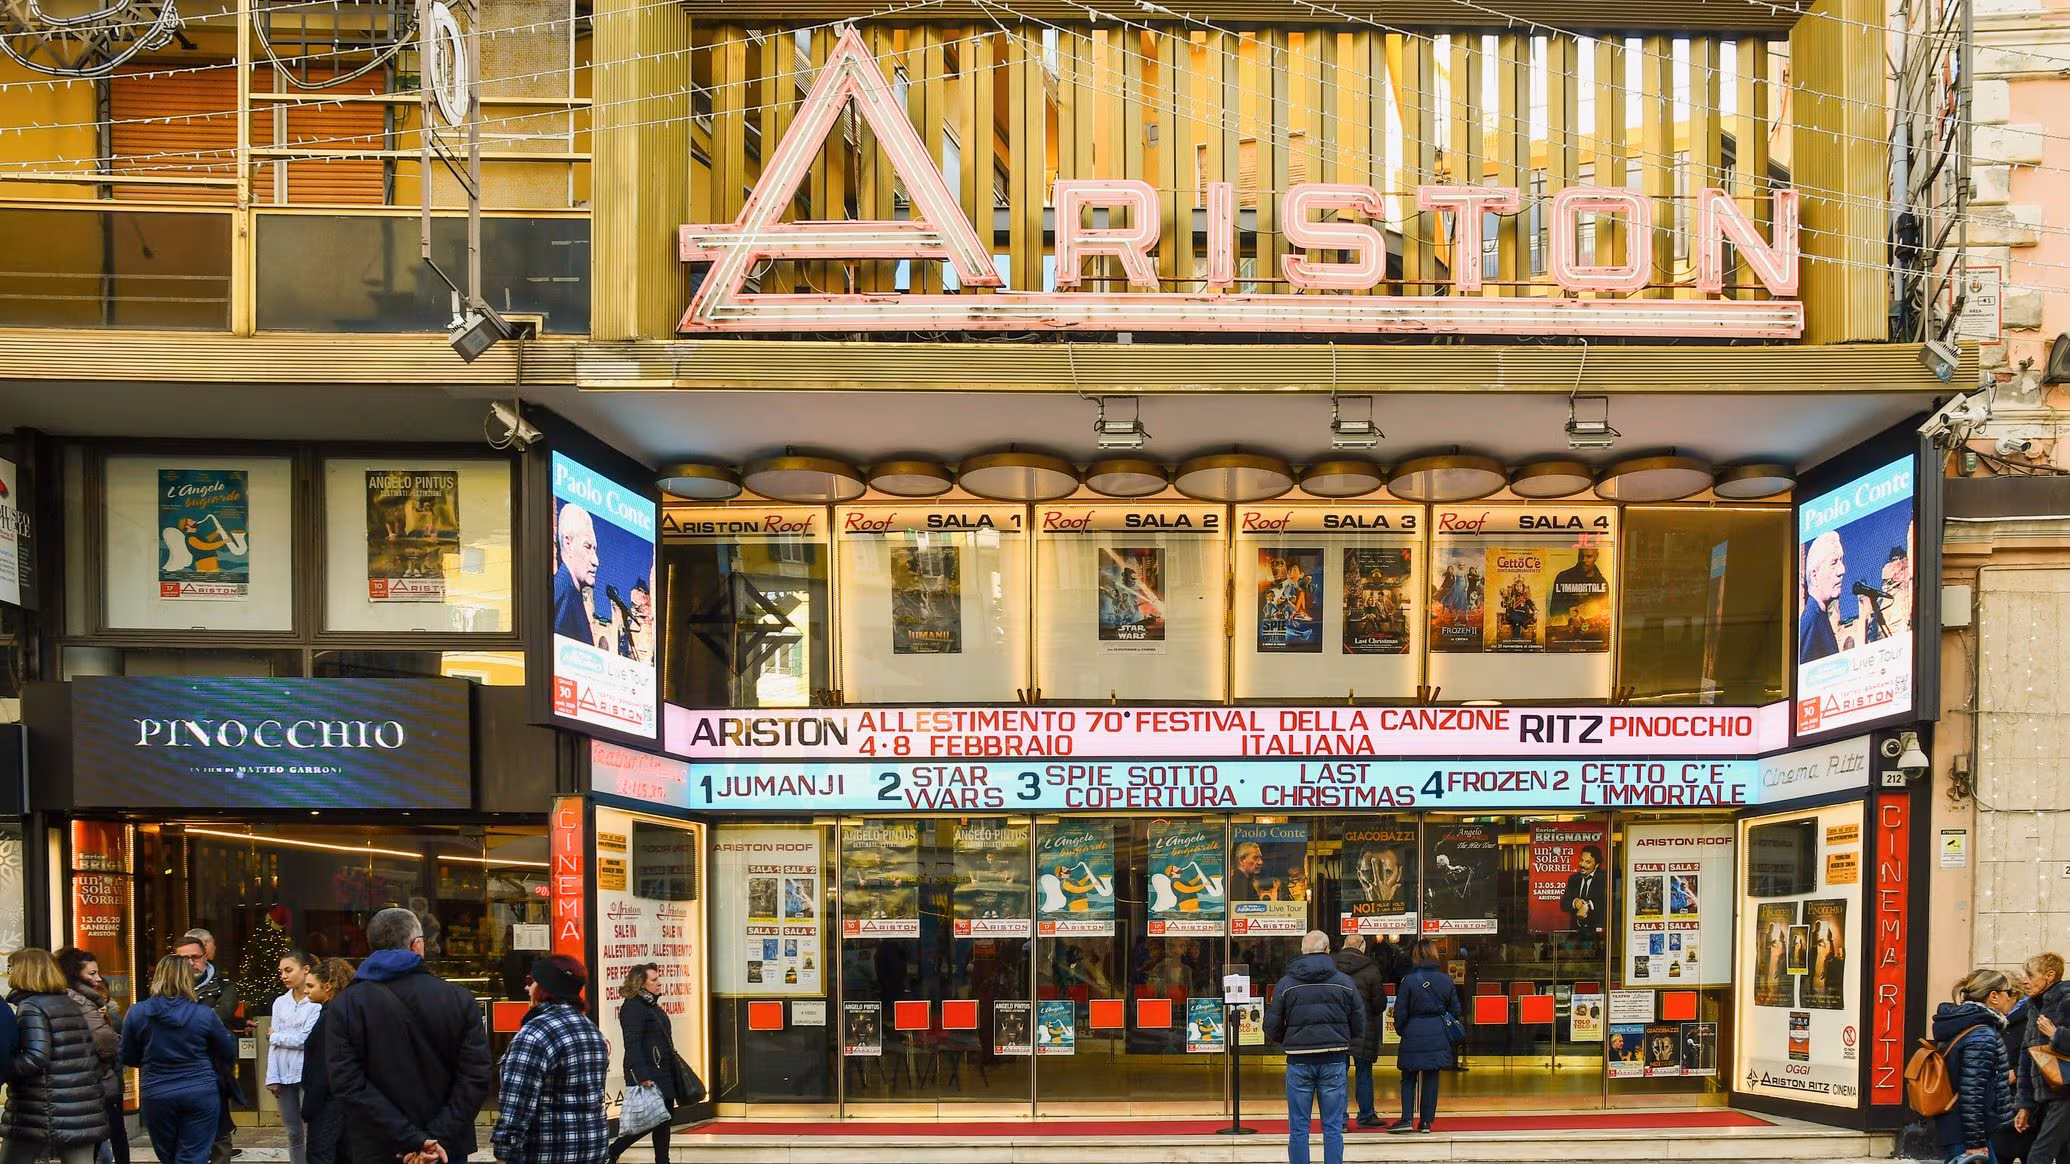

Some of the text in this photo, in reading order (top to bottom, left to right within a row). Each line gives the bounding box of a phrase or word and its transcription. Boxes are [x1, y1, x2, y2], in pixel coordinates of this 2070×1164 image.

[678, 24, 1804, 336] ARISTON
[167, 480, 225, 498] L'Angelo
[369, 476, 454, 489] ANGELO PINTUS
[555, 463, 651, 531] Paolo Conte
[1805, 470, 1910, 532] Paolo Conte
[661, 512, 815, 537] ARISTON Roof
[845, 512, 1021, 536] Roof SALA 1
[1043, 510, 1219, 535] Roof SALA 2
[1242, 511, 1417, 535] Roof SALA 3
[1438, 512, 1610, 536] Roof SALA 4
[1555, 583, 1606, 593] L'IMMORTALE
[1263, 620, 1287, 631] SPIE
[1441, 626, 1472, 635] FROZEN
[1118, 632, 1146, 640] WARS
[1852, 648, 1904, 671] Live Tour
[579, 687, 643, 724] ARISTON
[1821, 689, 1894, 718] ARISTON
[857, 711, 1076, 733] ALLESTIMENTO
[1136, 711, 1265, 732] FESTIVAL
[1279, 710, 1369, 732] DELLA
[1380, 709, 1510, 731] CANZONE
[1609, 716, 1752, 737] PINOCCHIO
[132, 718, 405, 749] PINOCCHIO
[690, 717, 848, 747] ARISTON
[1519, 714, 1603, 743] RITZ
[930, 735, 1073, 756] FEBBRAIO
[1241, 734, 1375, 757] ITALIANA
[238, 766, 285, 774] MATTEO
[1300, 763, 1371, 784] LAST
[1581, 763, 1665, 784] CETTO
[878, 766, 988, 800] 2 STAR
[1017, 765, 1218, 800] 3 SPIE SOTTO
[1420, 770, 1570, 799] 4 FROZEN 2
[1886, 774, 1902, 784] 212
[700, 774, 844, 803] 1 JUMANJI
[1580, 783, 1746, 805] L'IMMORTALE
[904, 788, 1004, 809] WARS
[1065, 786, 1238, 808] COPERTURA
[1262, 786, 1415, 808] CHRISTMAS
[842, 830, 917, 841] ANGELO PINTUS
[954, 830, 1028, 841] ANGELO PINTUS
[1234, 827, 1306, 838] Paolo Conte
[1345, 831, 1416, 841] GIACOBAZZI
[1456, 828, 1482, 838] Angelo
[1535, 832, 1602, 842] BRIGNANO
[713, 843, 814, 852] ARISTON ROOF
[1044, 832, 1094, 849] L'Angelo
[1156, 832, 1206, 849] L'Angelo
[1636, 837, 1733, 847] ARISTON ROOF
[1536, 853, 1559, 863] sola
[1693, 863, 1700, 871] 2
[558, 808, 580, 941] CINEMA
[81, 884, 111, 895] sola
[1269, 904, 1284, 912] Live
[1286, 904, 1302, 912] Tour
[1353, 903, 1375, 914] NOI
[1762, 905, 1794, 917] PINOCCHIO
[1808, 902, 1843, 914] PINOCCHIO
[862, 920, 917, 931] ARISTON
[972, 920, 1028, 931] ARISTON
[1056, 921, 1104, 932] ARISTON
[1166, 921, 1213, 932] ARISTON
[1248, 919, 1296, 930] ARISTON
[1358, 918, 1407, 929] ARISTON
[1440, 920, 1487, 930] ARISTON
[614, 924, 637, 938] SALE IN
[662, 925, 676, 938] SALE
[748, 927, 779, 935] SALA 3
[603, 944, 648, 958] ALLESTIMENTO
[652, 944, 693, 957] ALLESTIMENTO
[1875, 805, 1902, 1089] CINEMA RITZ
[606, 966, 618, 980] PER
[666, 964, 690, 977] FESTIVAL
[1785, 1064, 1811, 1075] OGGI
[1761, 1071, 1857, 1097] ARISTON RITZ CINEMA
